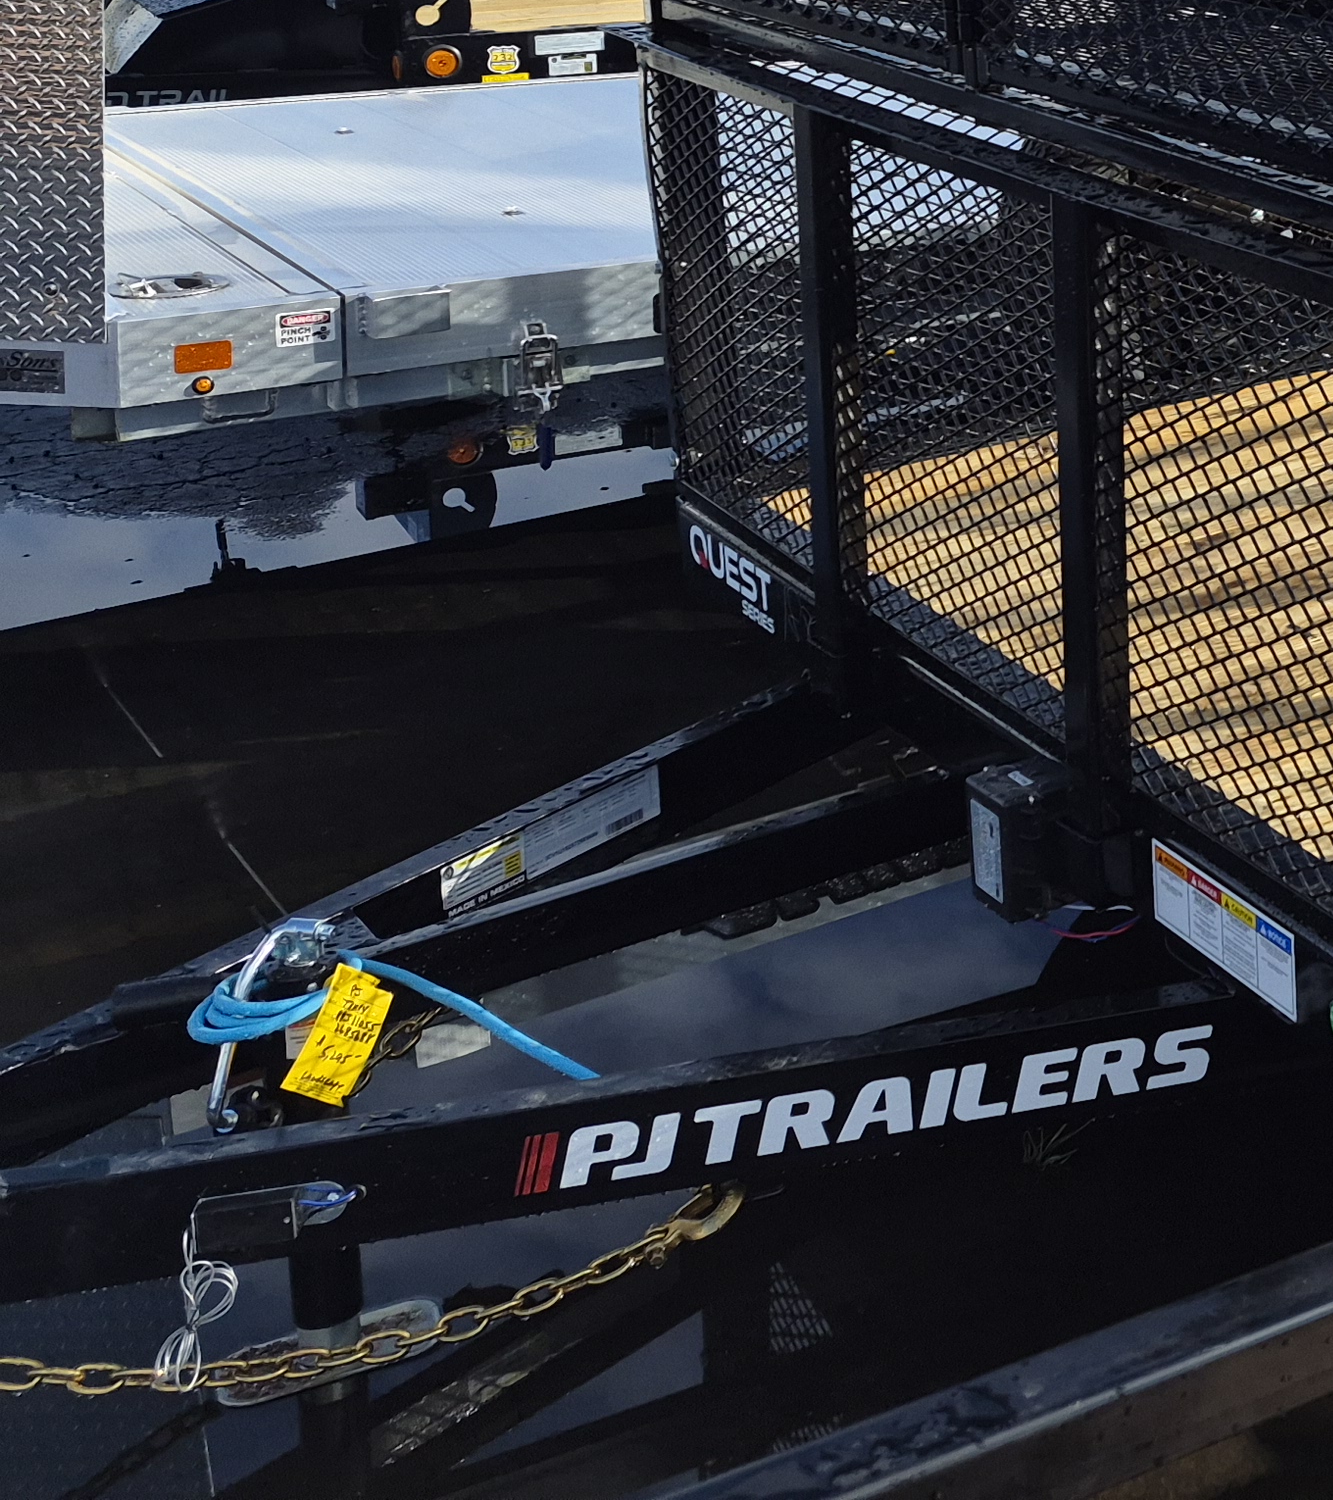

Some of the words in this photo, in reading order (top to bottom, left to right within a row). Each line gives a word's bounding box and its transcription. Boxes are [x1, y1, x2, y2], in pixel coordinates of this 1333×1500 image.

[281, 327, 312, 337] PINCH
[285, 314, 325, 327] DANGER
[281, 335, 311, 346] POINT
[689, 524, 771, 611] QUEST
[741, 599, 776, 635] SERIES
[448, 899, 477, 918] MADE
[478, 892, 488, 904] IN
[489, 875, 525, 898] MEXICO
[559, 1112, 682, 1190] PJ
[693, 1024, 1213, 1166] TRAILERS
